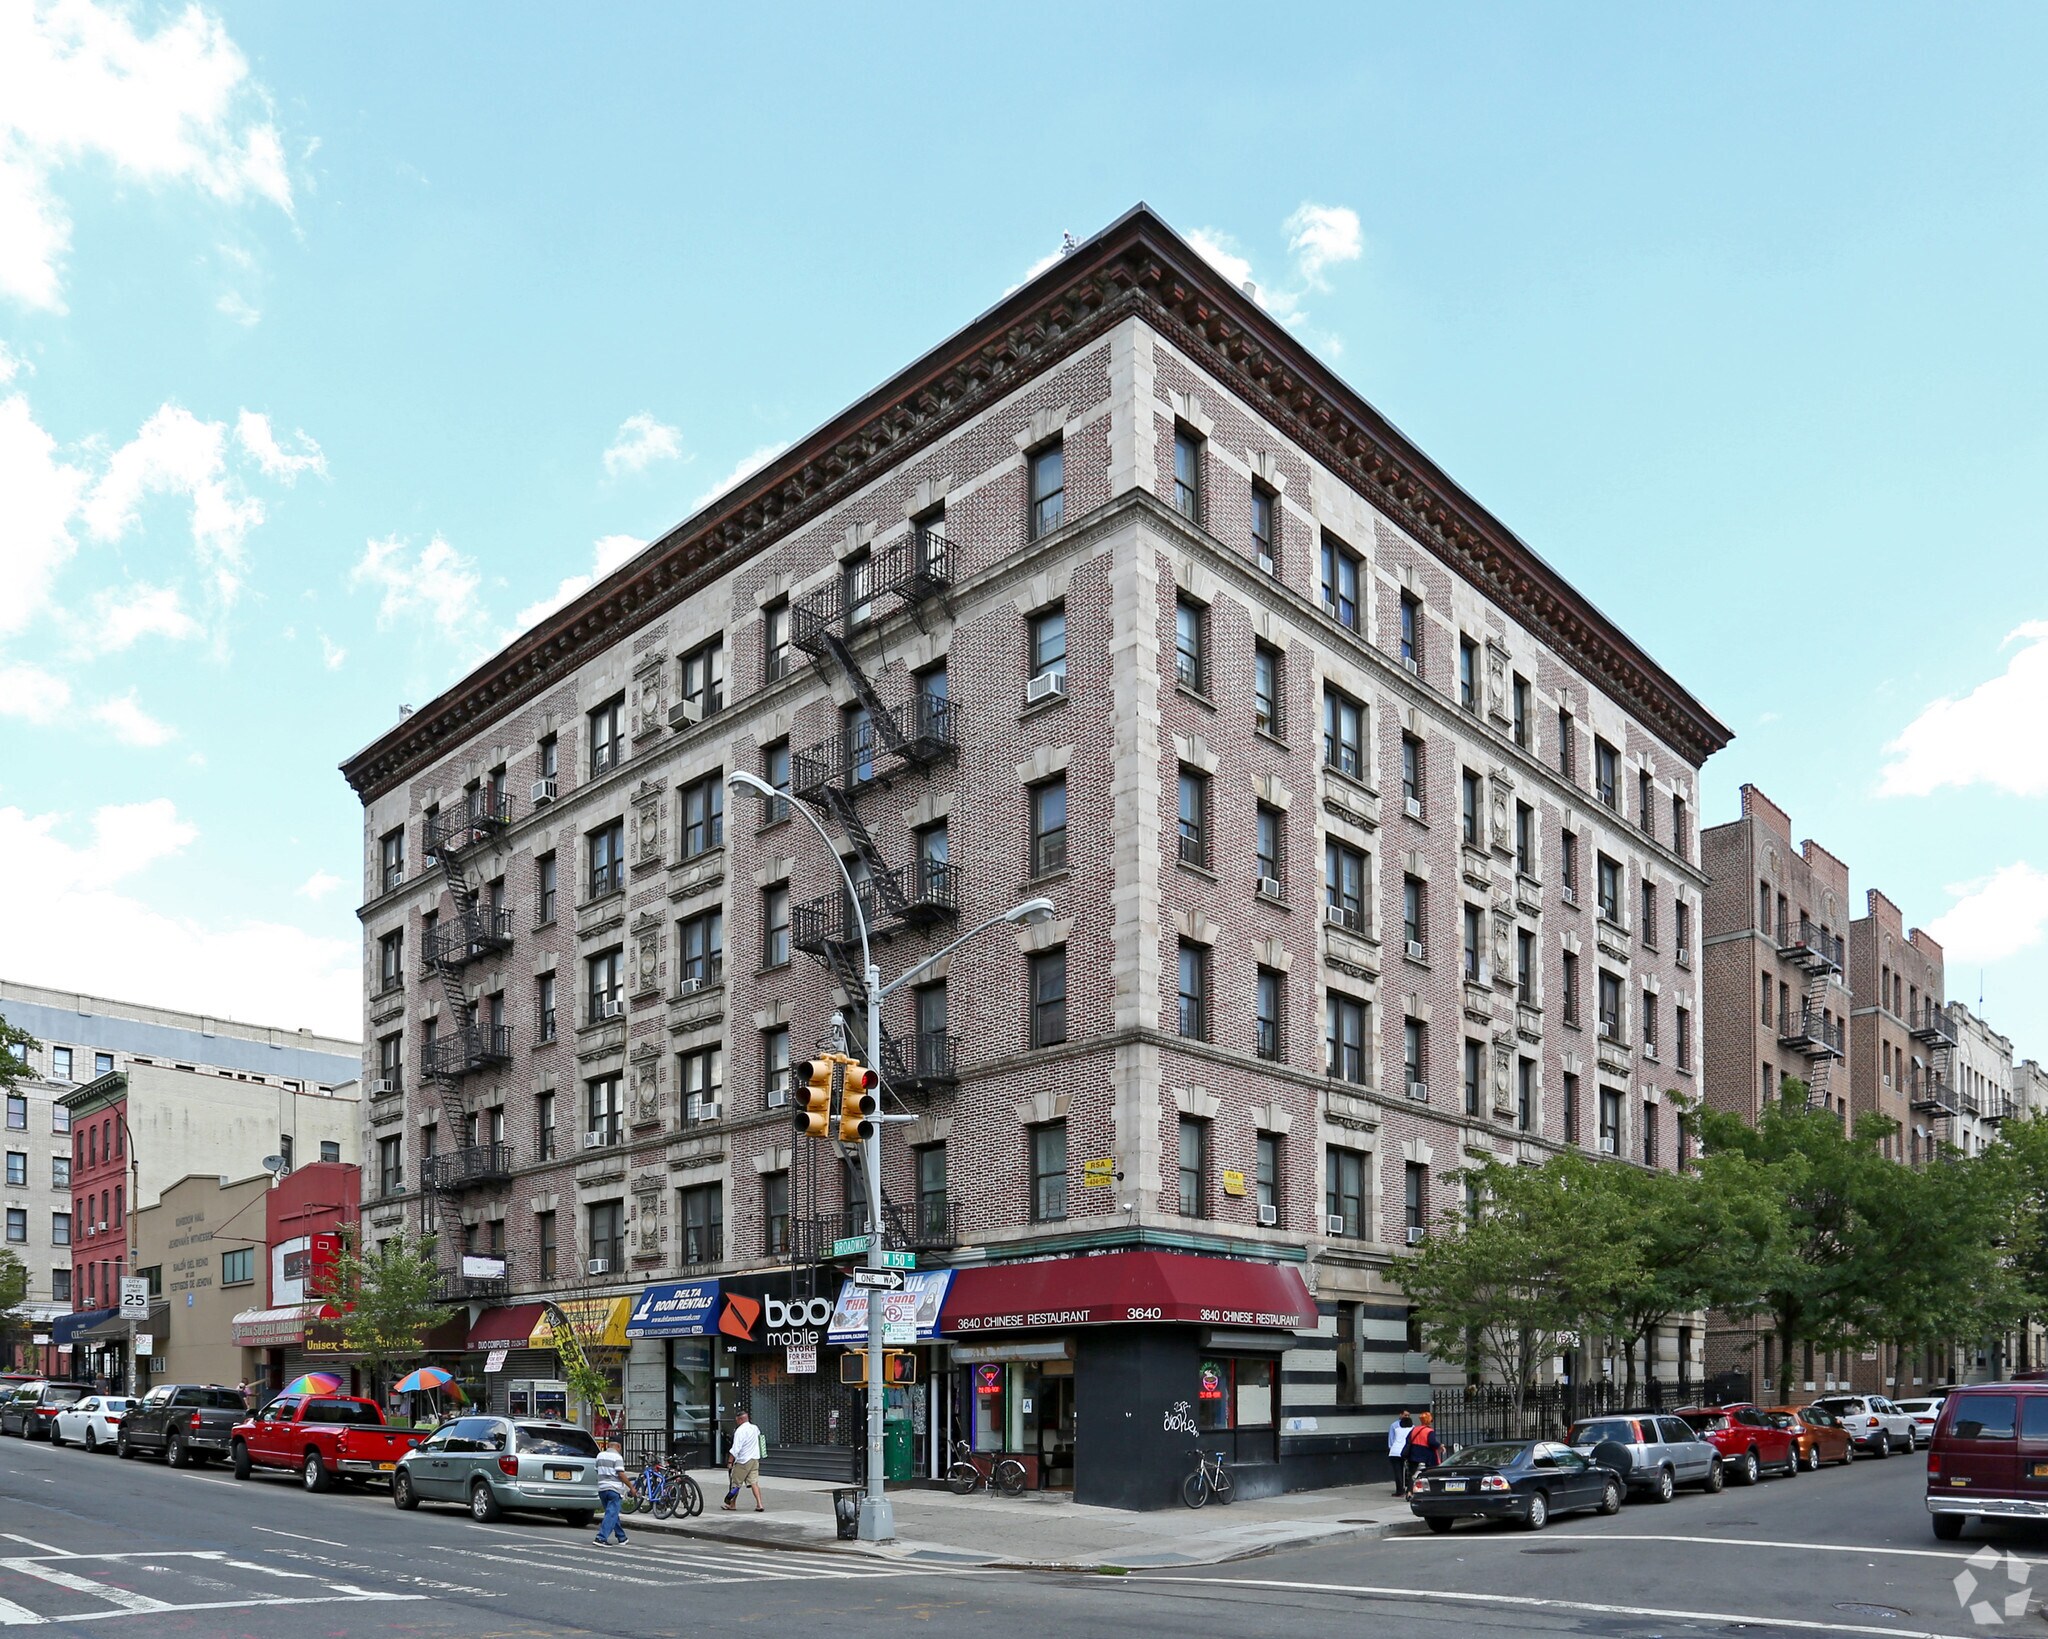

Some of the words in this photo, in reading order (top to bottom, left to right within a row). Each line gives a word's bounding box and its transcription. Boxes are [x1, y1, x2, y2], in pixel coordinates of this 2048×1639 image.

[1090, 1161, 1106, 1169] RSA
[834, 1237, 868, 1255] BROADWAY
[883, 1253, 890, 1265] W
[892, 1253, 905, 1266] 150
[860, 1274, 875, 1283] ONE
[883, 1275, 898, 1285] WAY
[673, 1288, 702, 1299] DELTA
[124, 1294, 145, 1306] 25
[653, 1299, 677, 1312] ROOM
[676, 1296, 714, 1310] RENTALS
[1126, 1307, 1162, 1320] 3640
[1200, 1308, 1220, 1321] 3640
[1222, 1310, 1254, 1324] CHINESE
[1255, 1313, 1300, 1326] RESTAURANT
[957, 1318, 981, 1330] 3640
[983, 1314, 1024, 1328] CHINESE
[1027, 1310, 1091, 1325] RESTAURANT
[253, 1322, 276, 1336] SUPPLY
[253, 1335, 296, 1344] FERRETERIA
[766, 1328, 819, 1346] mobile
[306, 1339, 340, 1352] Unisex
[477, 1340, 487, 1350] DUO
[487, 1339, 510, 1349] COMPUTER
[788, 1345, 816, 1353] STORE
[800, 1352, 816, 1360] RENT
[1024, 1400, 1031, 1409] A
